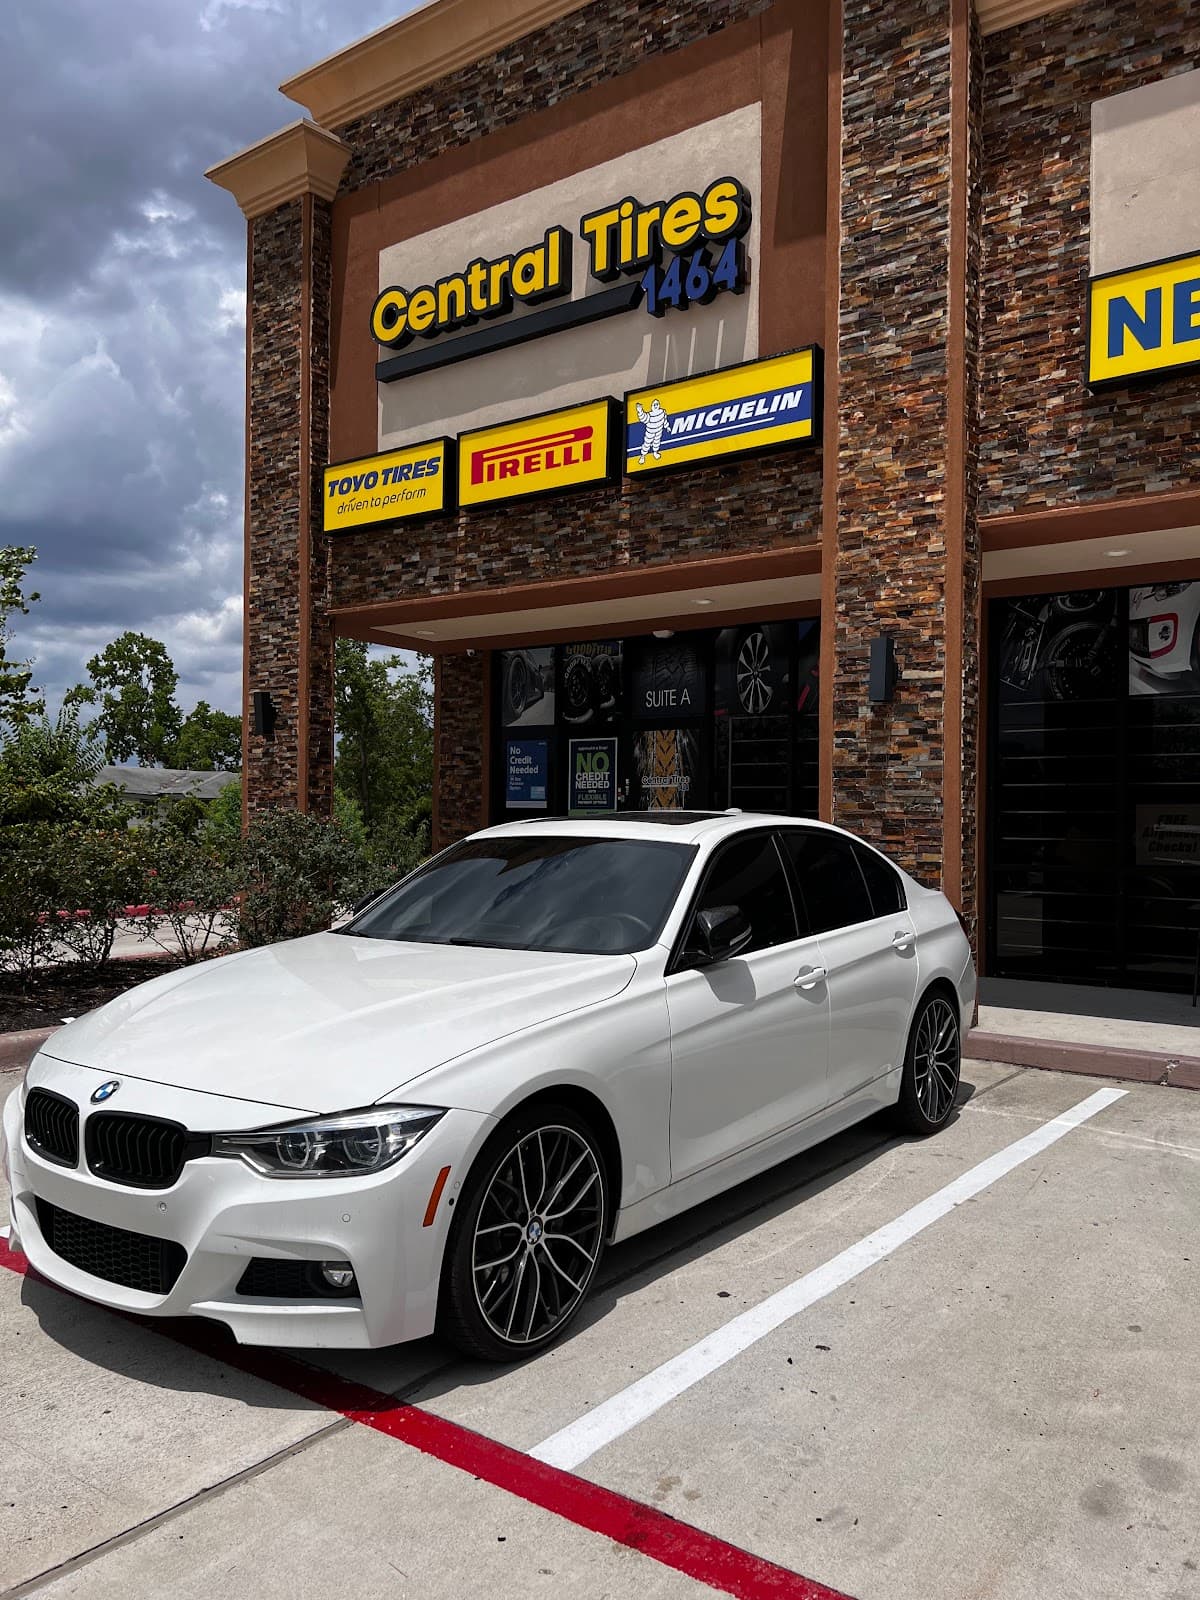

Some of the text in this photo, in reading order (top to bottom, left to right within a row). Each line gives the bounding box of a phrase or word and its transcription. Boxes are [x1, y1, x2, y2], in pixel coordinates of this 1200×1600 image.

[371, 181, 740, 344] Central Tires
[640, 236, 739, 314] 1464
[670, 389, 804, 435] MICHELIN
[471, 425, 594, 486] PIRELLI
[328, 456, 442, 498] TOYO TIRES
[337, 488, 427, 514] driven to perform
[645, 687, 691, 708] SUITE A
[509, 745, 521, 755] No
[509, 755, 533, 765] Credit
[509, 764, 539, 775] Needed
[575, 751, 610, 773] NO
[575, 771, 611, 781] CREDIT
[575, 780, 610, 790] NEEDED
[1148, 841, 1198, 853] Checks!
